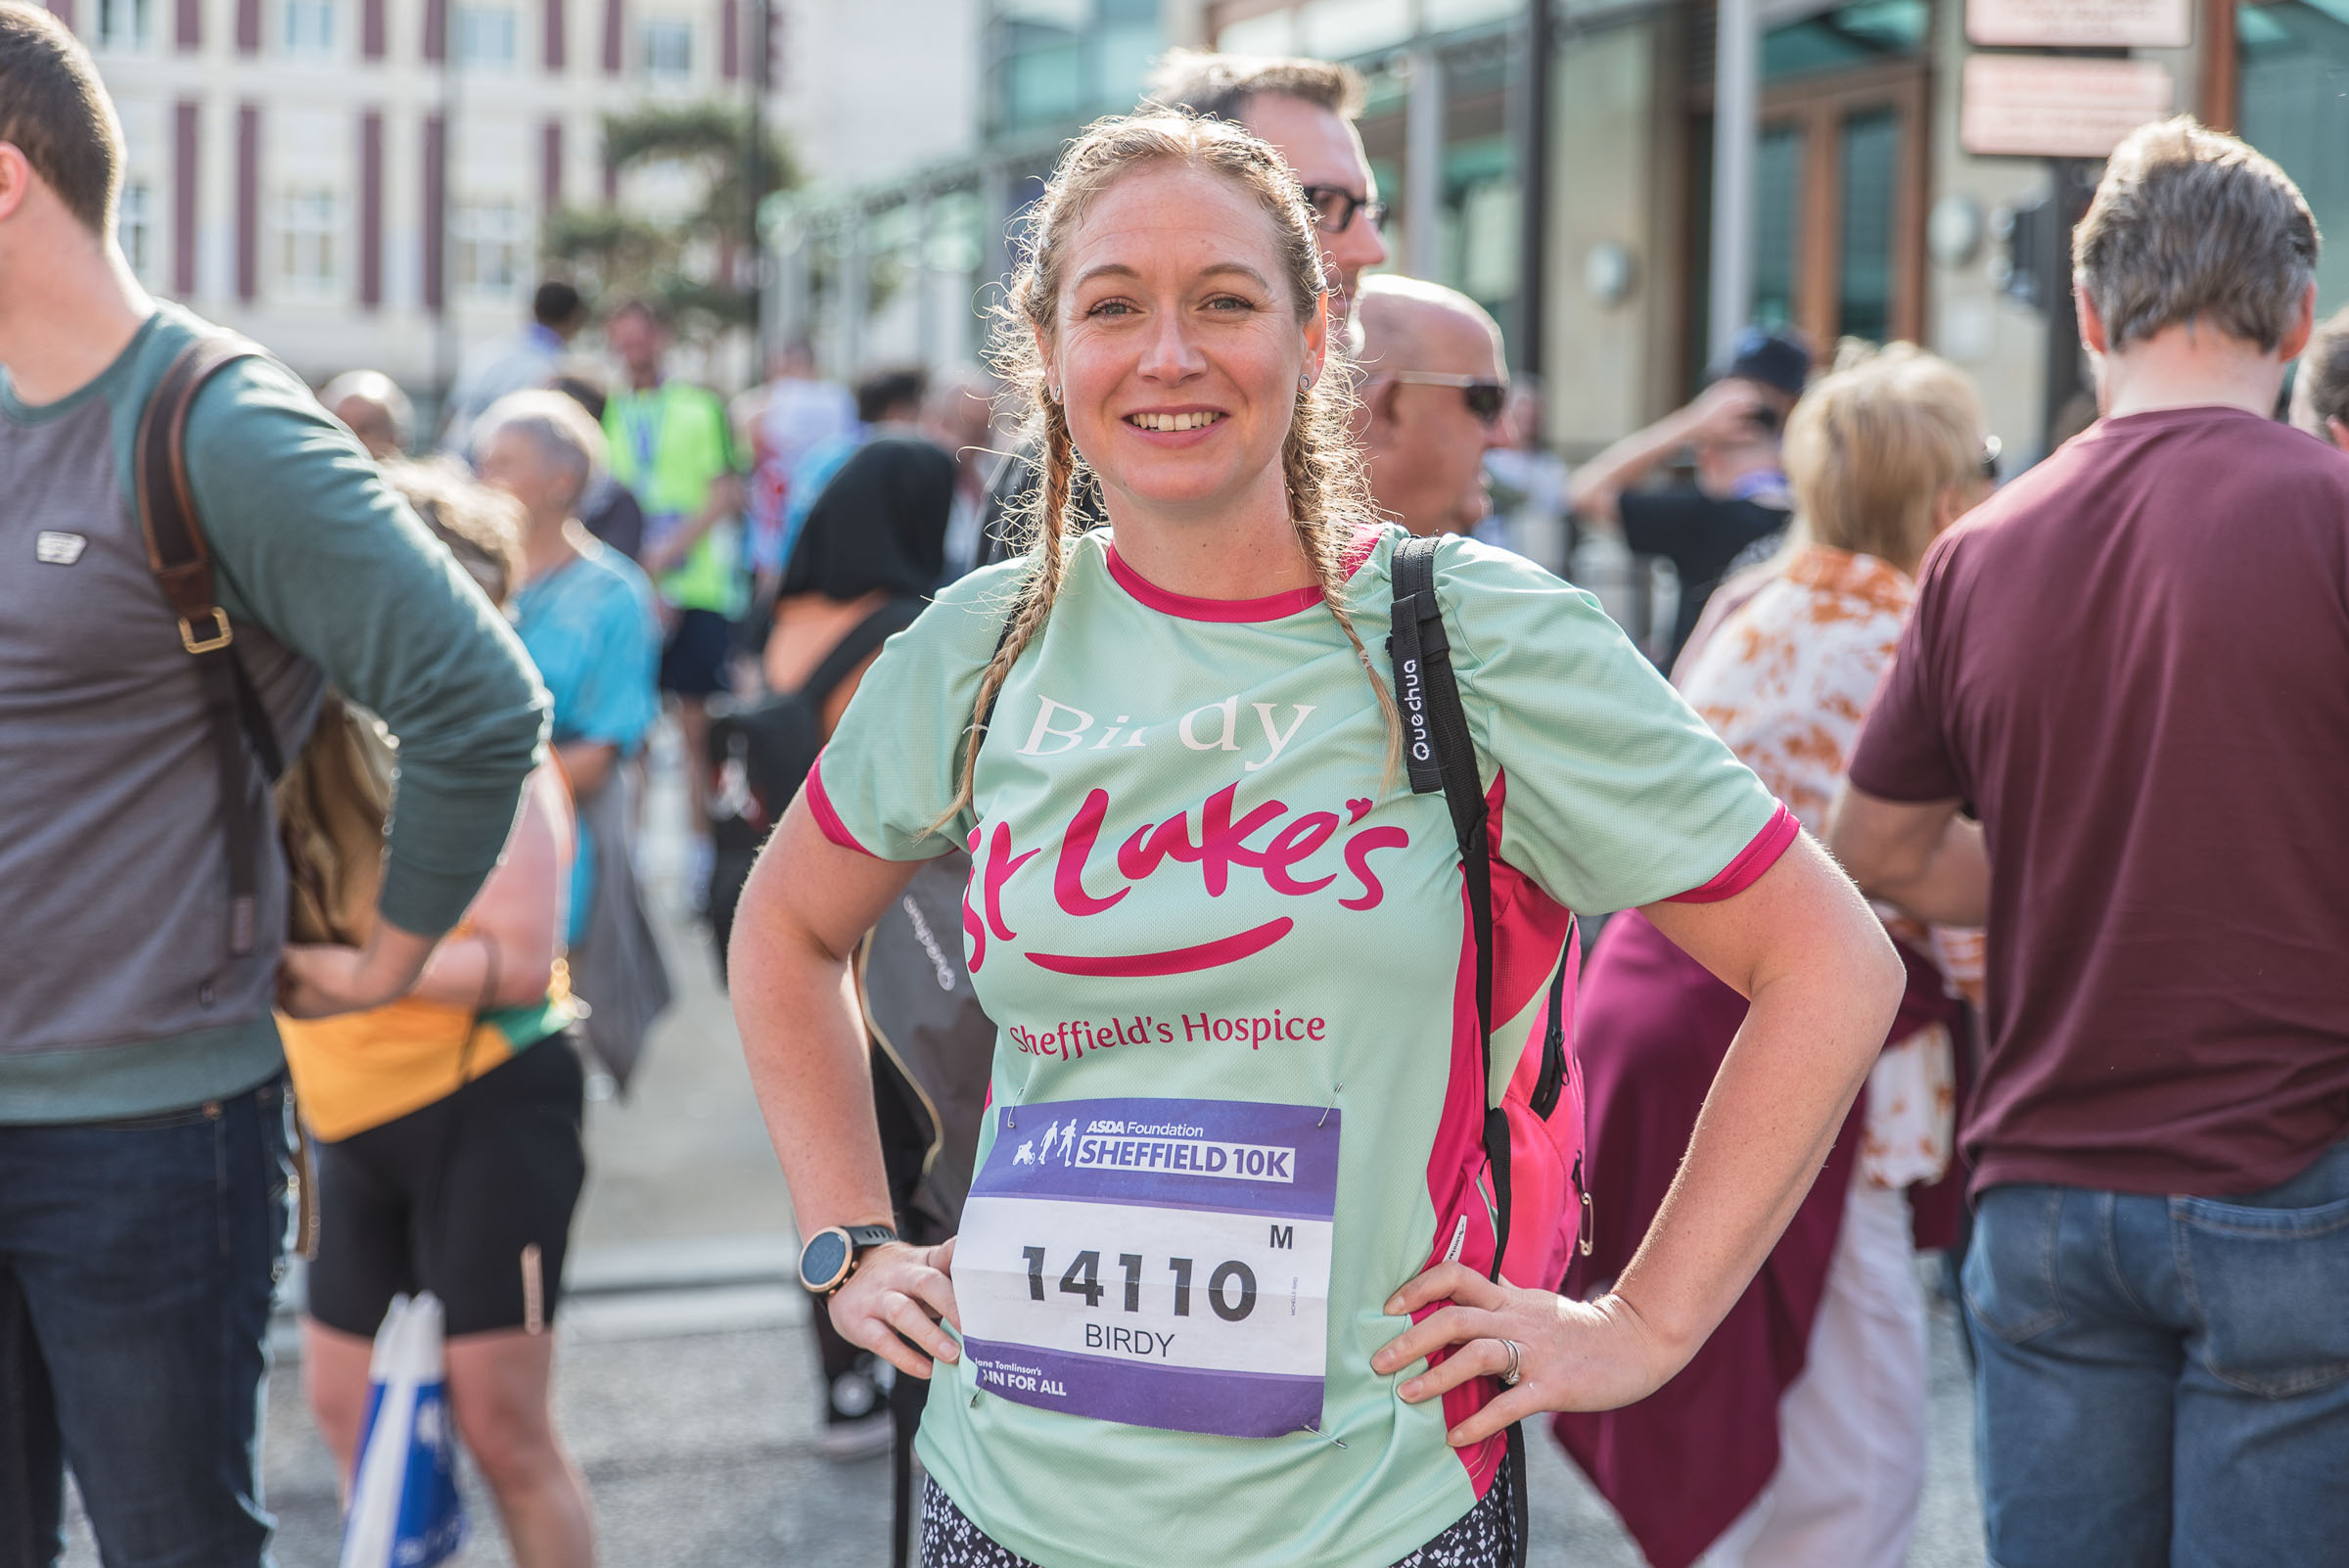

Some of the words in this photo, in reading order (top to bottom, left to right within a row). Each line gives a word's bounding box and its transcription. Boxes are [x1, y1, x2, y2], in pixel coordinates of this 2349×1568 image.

[1404, 659, 1429, 761] Quechua
[1054, 779, 1409, 916] Luke's
[1009, 1015, 1174, 1061] Sheffield's
[1180, 1008, 1326, 1050] Hospice
[1086, 1120, 1125, 1134] ASDA
[1127, 1121, 1203, 1137] Foundation
[1080, 1139, 1227, 1174] SHEFFIELD
[1232, 1148, 1290, 1178] 10K
[1269, 1224, 1293, 1250] M
[1022, 1245, 1257, 1322] 14110
[1085, 1323, 1174, 1358] BIRDY
[995, 1360, 1041, 1376] Tomlinson's
[1007, 1373, 1036, 1392] FOR
[1039, 1379, 1067, 1397] ALL
